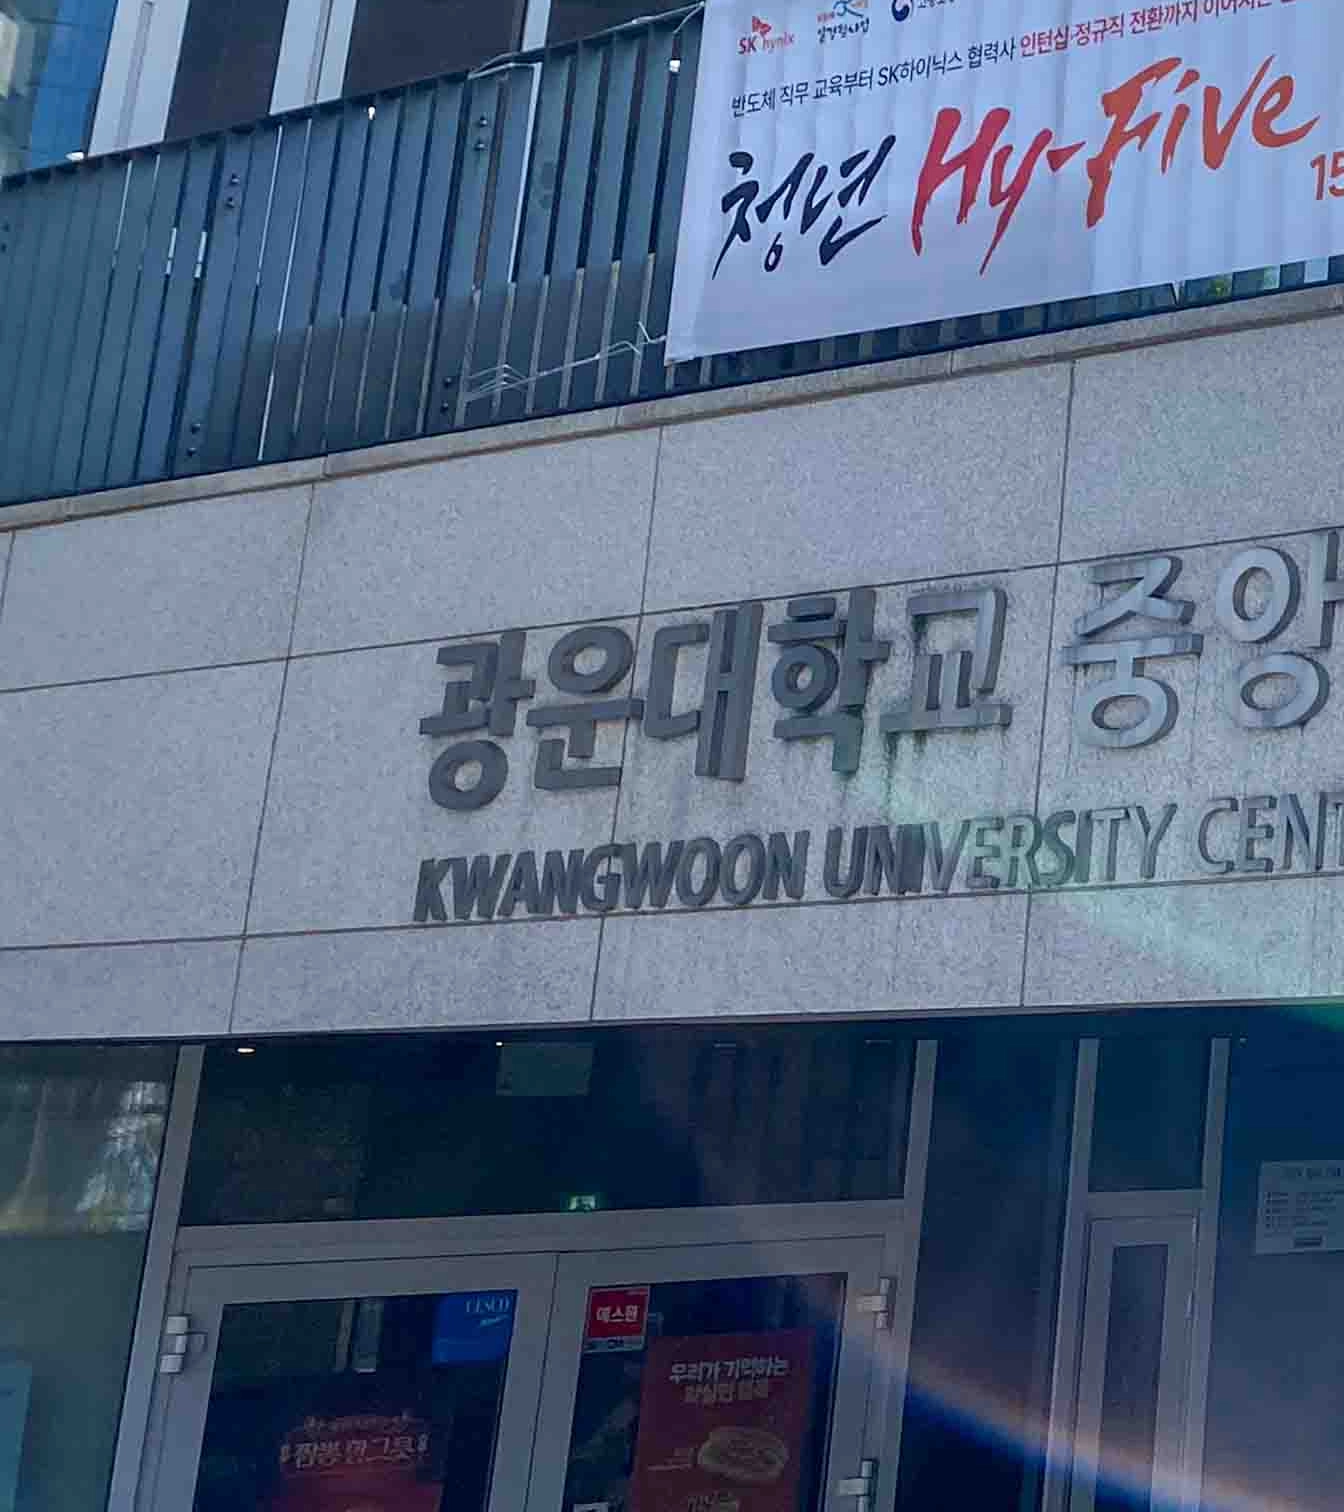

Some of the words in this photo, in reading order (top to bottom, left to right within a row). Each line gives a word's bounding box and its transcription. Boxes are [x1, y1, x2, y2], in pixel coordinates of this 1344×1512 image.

[731, 91, 776, 118] 반도체
[779, 82, 809, 106] 직무
[813, 67, 873, 99] 교육부터
[878, 50, 962, 86] SK하이닉스
[967, 36, 1017, 69] 협력사
[738, 36, 757, 55] SK
[711, 134, 897, 281] 청년
[910, 53, 1320, 277] Hy-Five
[419, 586, 1013, 811] 광운대학교
[413, 828, 811, 923] KWANGWOON
[822, 802, 1178, 900] UNIVERSITY
